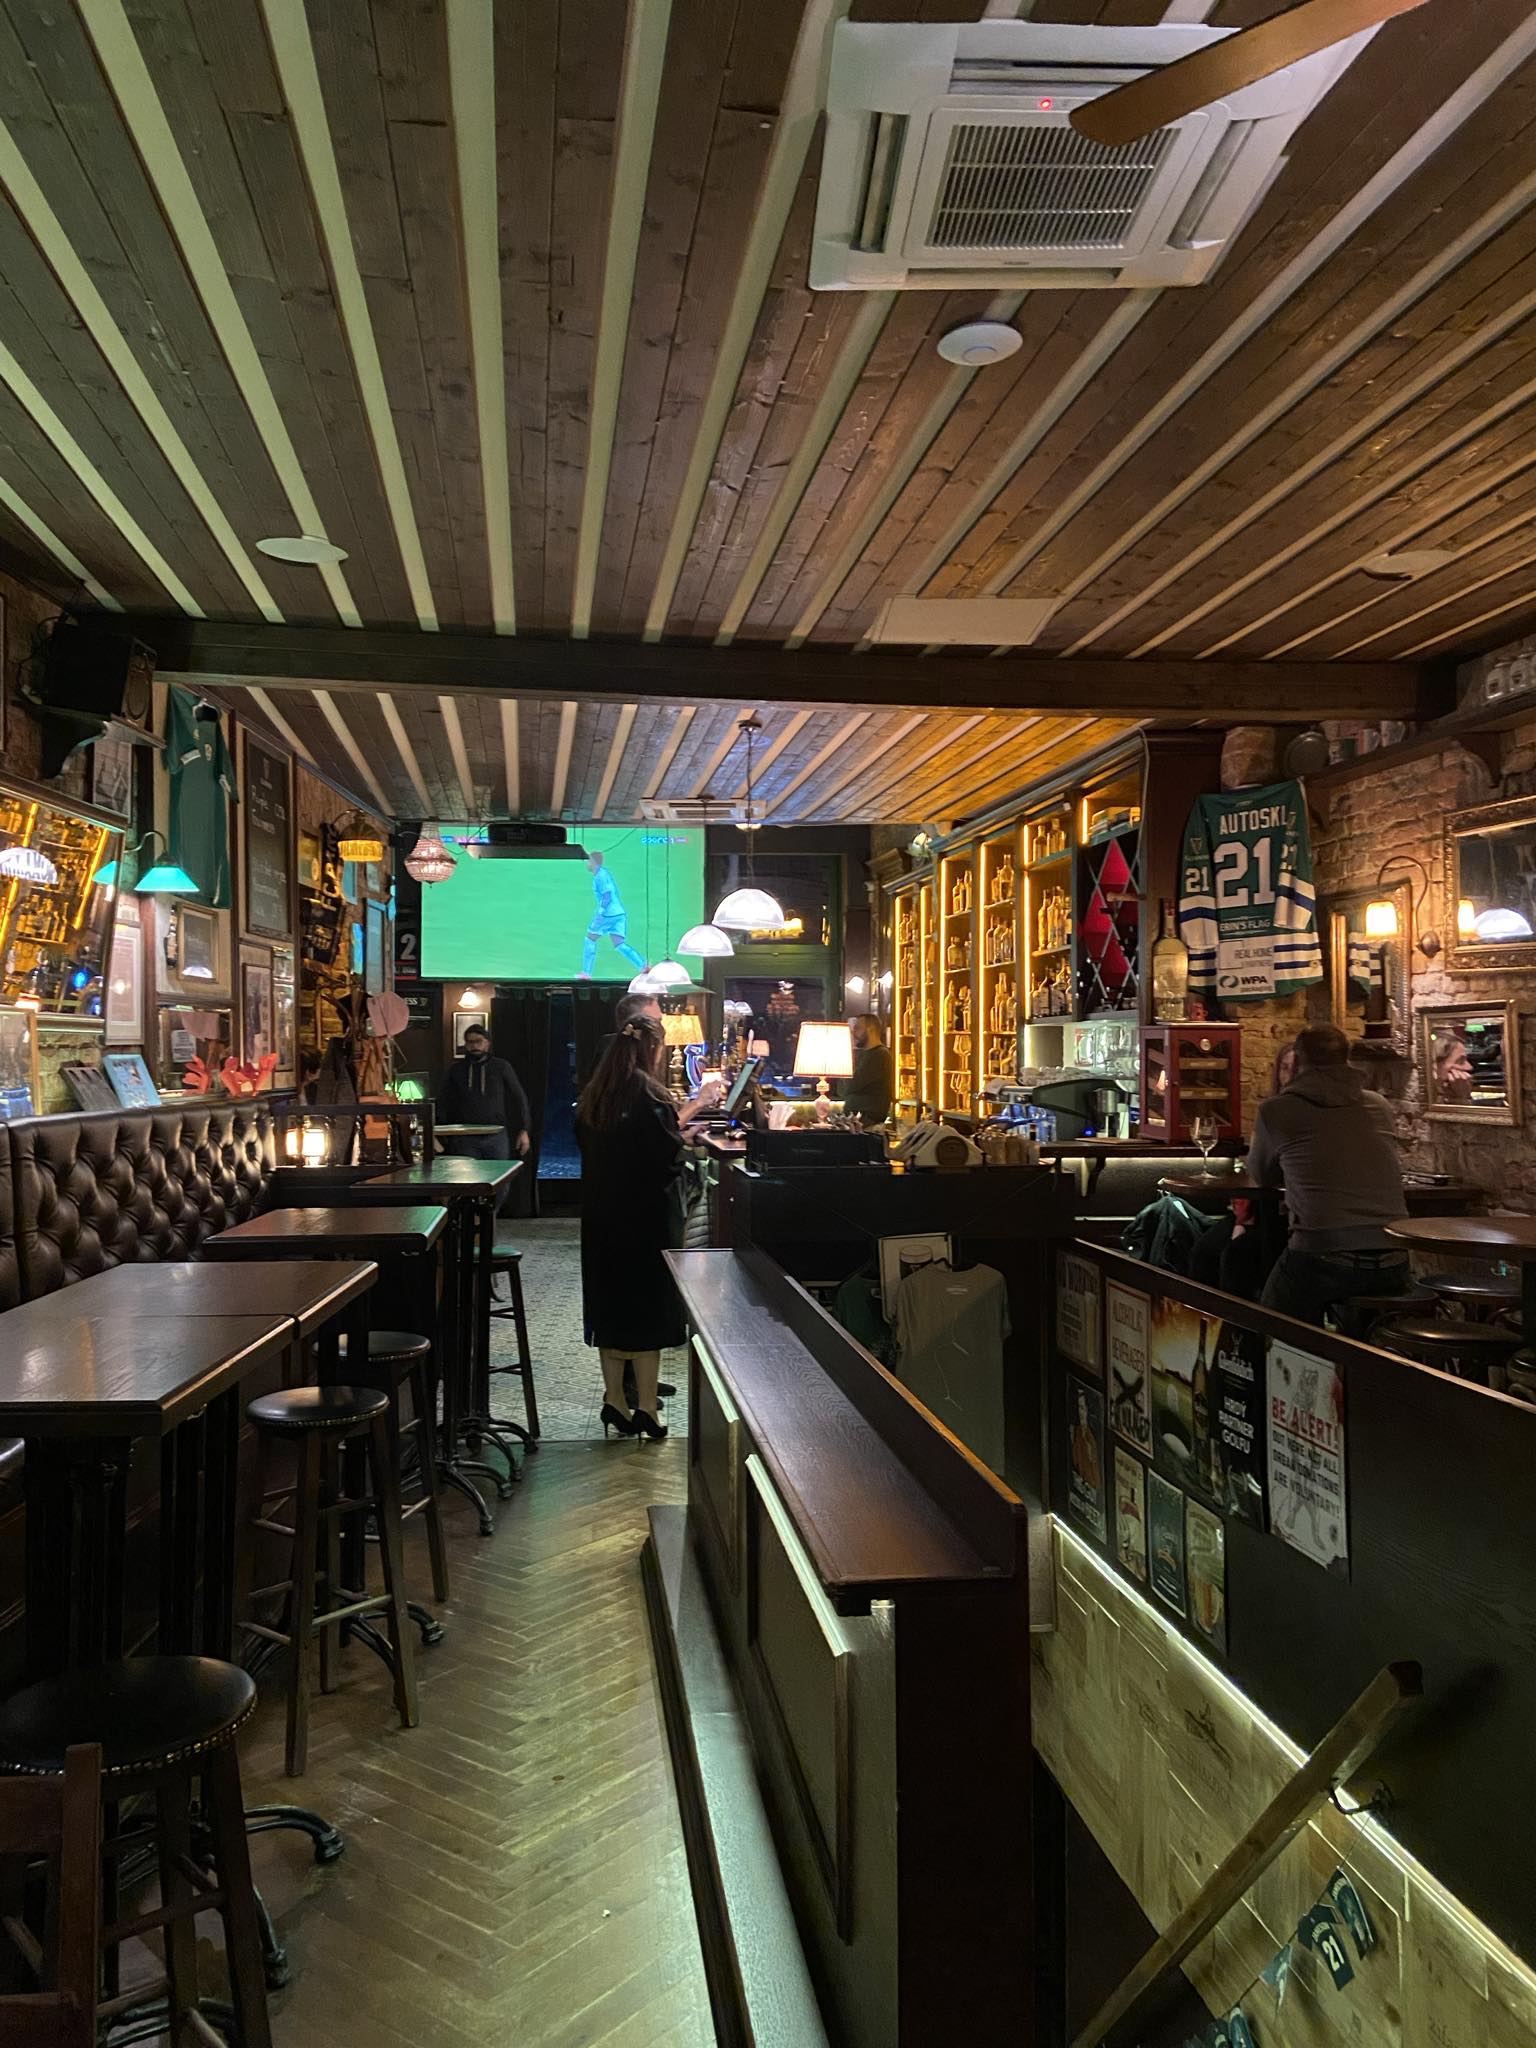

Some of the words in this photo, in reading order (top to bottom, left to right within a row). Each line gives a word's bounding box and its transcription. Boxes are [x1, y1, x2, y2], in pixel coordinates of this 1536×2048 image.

[1185, 866, 1209, 893] 21
[1213, 837, 1275, 908] 21
[1240, 975, 1268, 985] WPA
[1271, 1396, 1287, 1423] BE
[1289, 1406, 1339, 1450] ALERT!
[1321, 1935, 1345, 1972] 21
